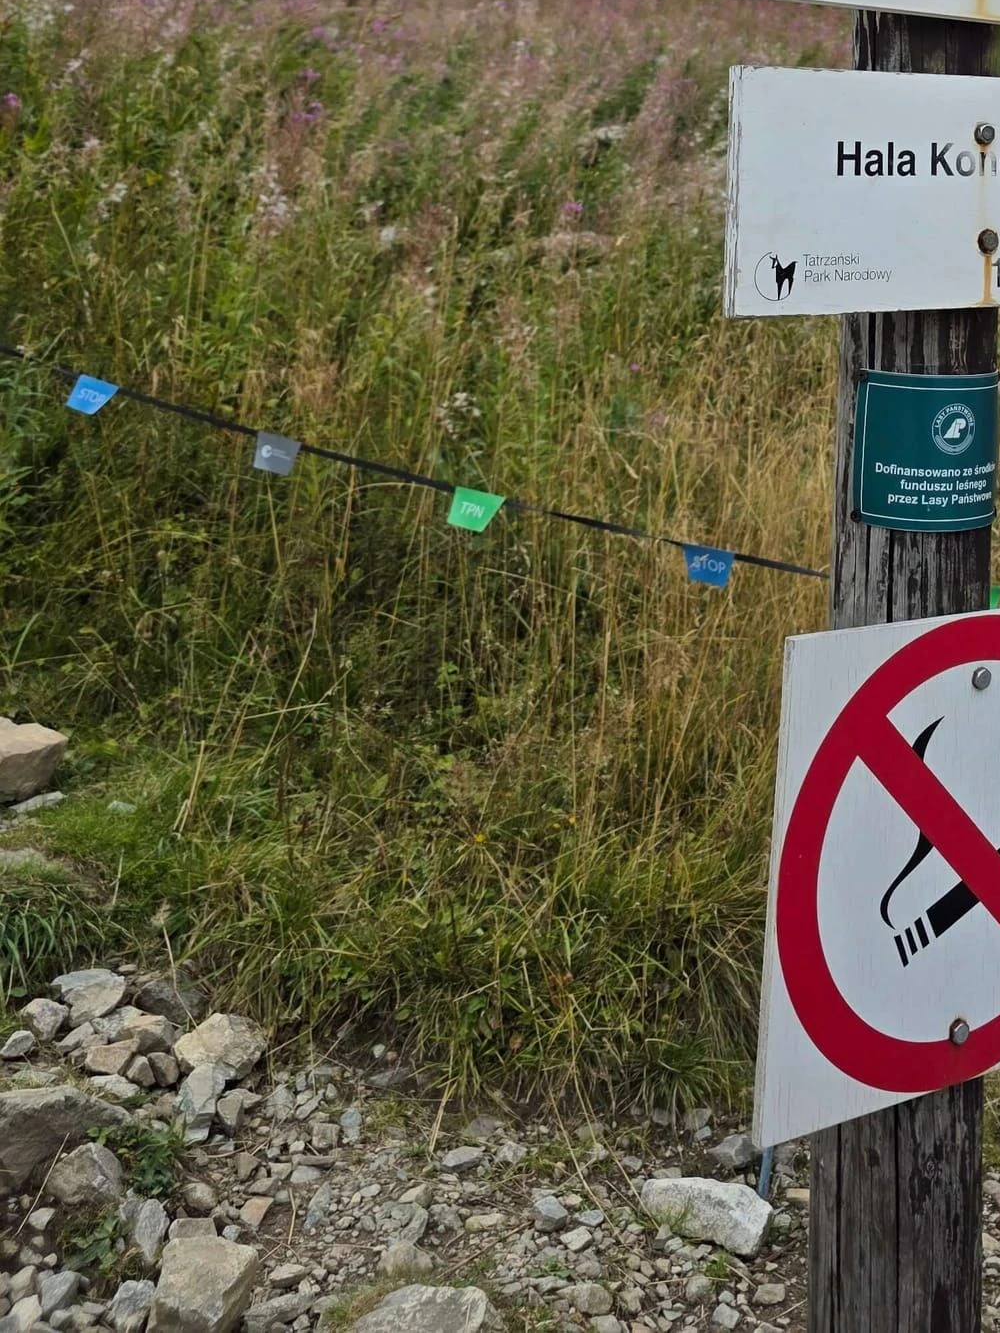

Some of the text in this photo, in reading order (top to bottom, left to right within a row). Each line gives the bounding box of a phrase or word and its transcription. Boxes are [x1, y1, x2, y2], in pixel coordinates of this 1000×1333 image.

[836, 140, 916, 177] Hala
[803, 252, 860, 266] Tatrzański
[804, 268, 891, 283] Park Narodowy
[77, 388, 108, 404] STOP
[875, 462, 960, 477] Dofinansowano
[963, 468, 972, 476] ze
[900, 479, 986, 491] funduszu leśnego
[888, 494, 918, 504] przez
[922, 494, 948, 507] Lasy
[460, 502, 485, 518] TPN
[692, 555, 726, 573] STOP
